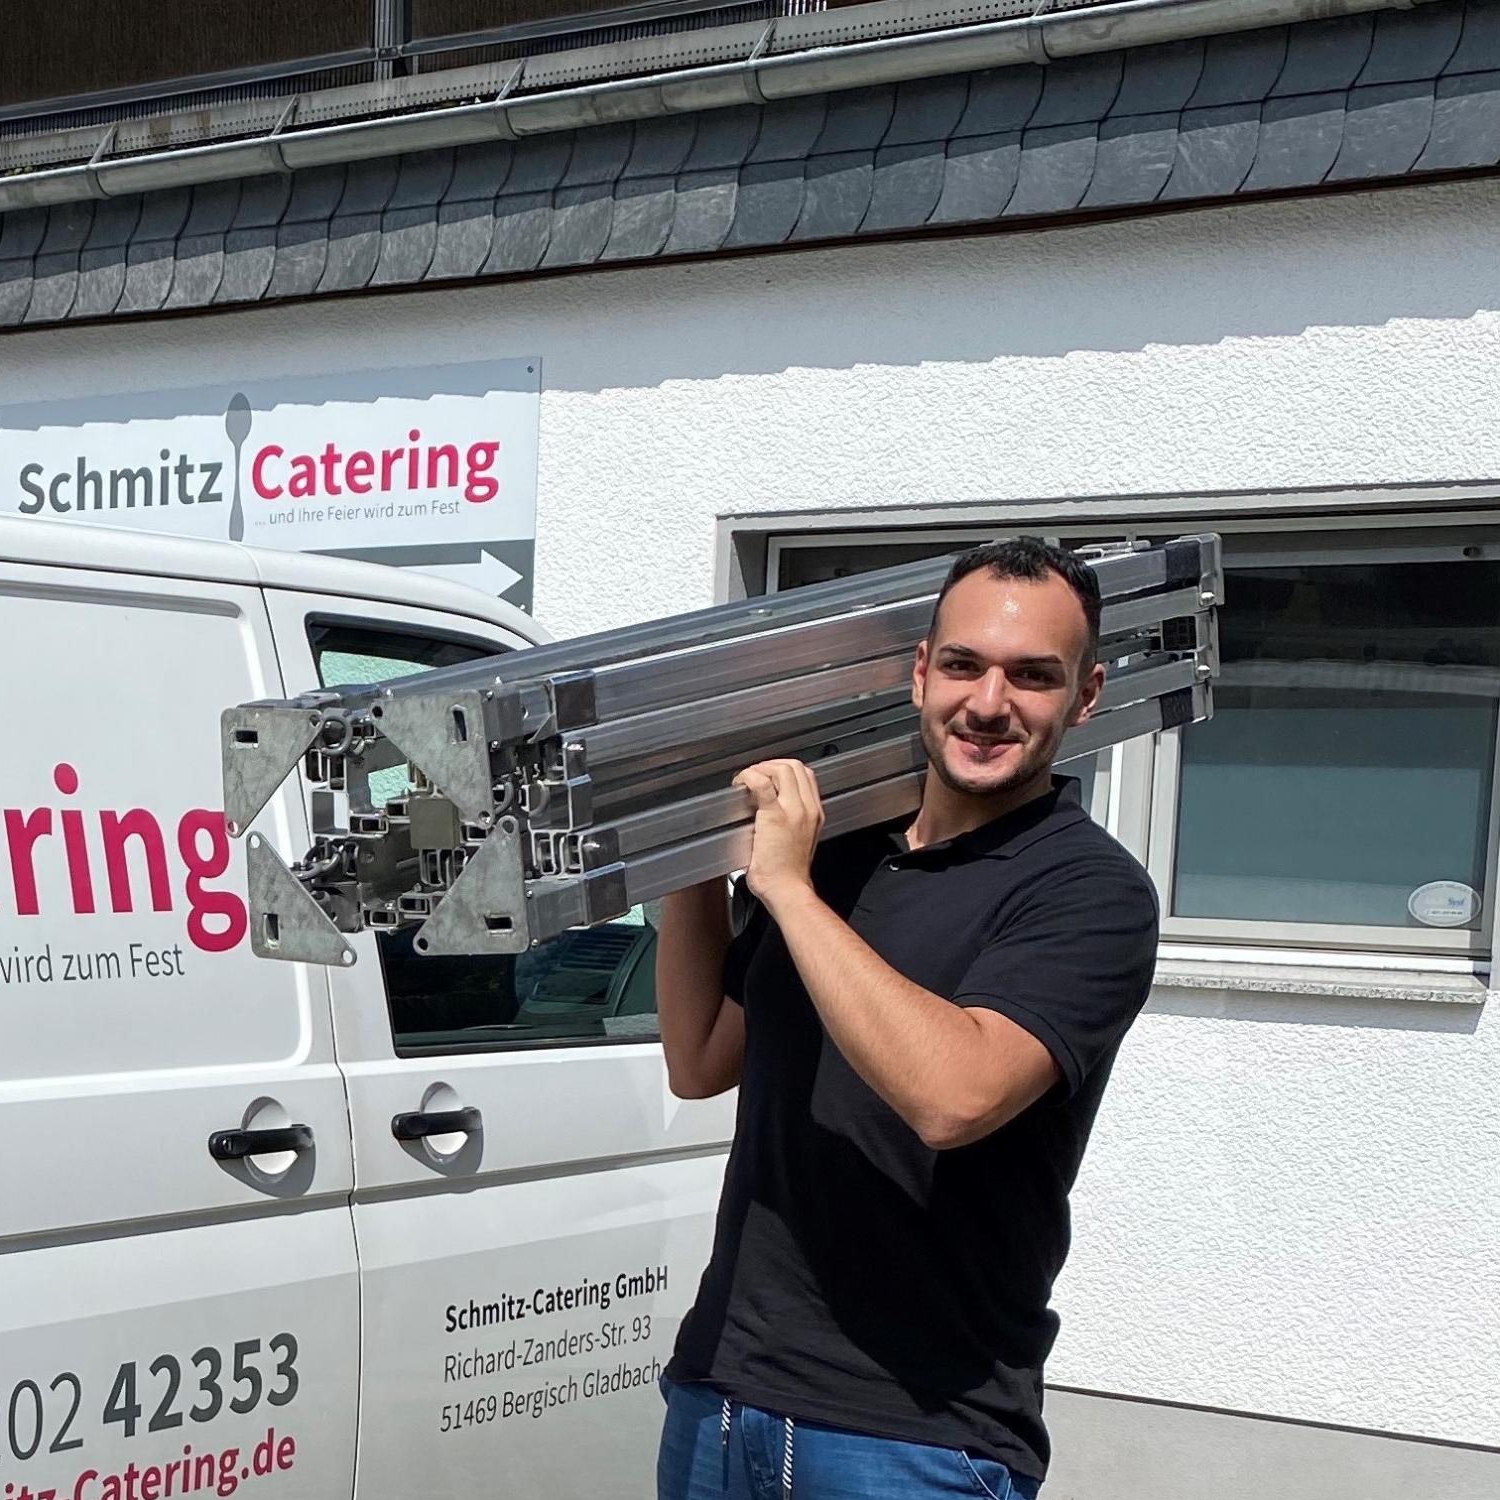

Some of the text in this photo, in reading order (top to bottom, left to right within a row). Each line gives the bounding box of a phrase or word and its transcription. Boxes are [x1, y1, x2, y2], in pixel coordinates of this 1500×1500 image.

[19, 428, 500, 514] Schmitz Catering
[269, 508, 295, 525] und
[298, 507, 325, 522] Ihre
[328, 505, 361, 521] Feier
[364, 502, 395, 519] wird
[397, 503, 428, 517] zum
[431, 500, 461, 515] Fest
[62, 953, 121, 980] zum
[130, 944, 185, 977] Fest
[446, 1266, 667, 1332] Schmitz-Catering GmbH
[445, 1315, 650, 1382] Richard-Zanders-Str. 93
[103, 1333, 298, 1438] 42353
[441, 1356, 660, 1432] 51469 Bergisch Gladbach
